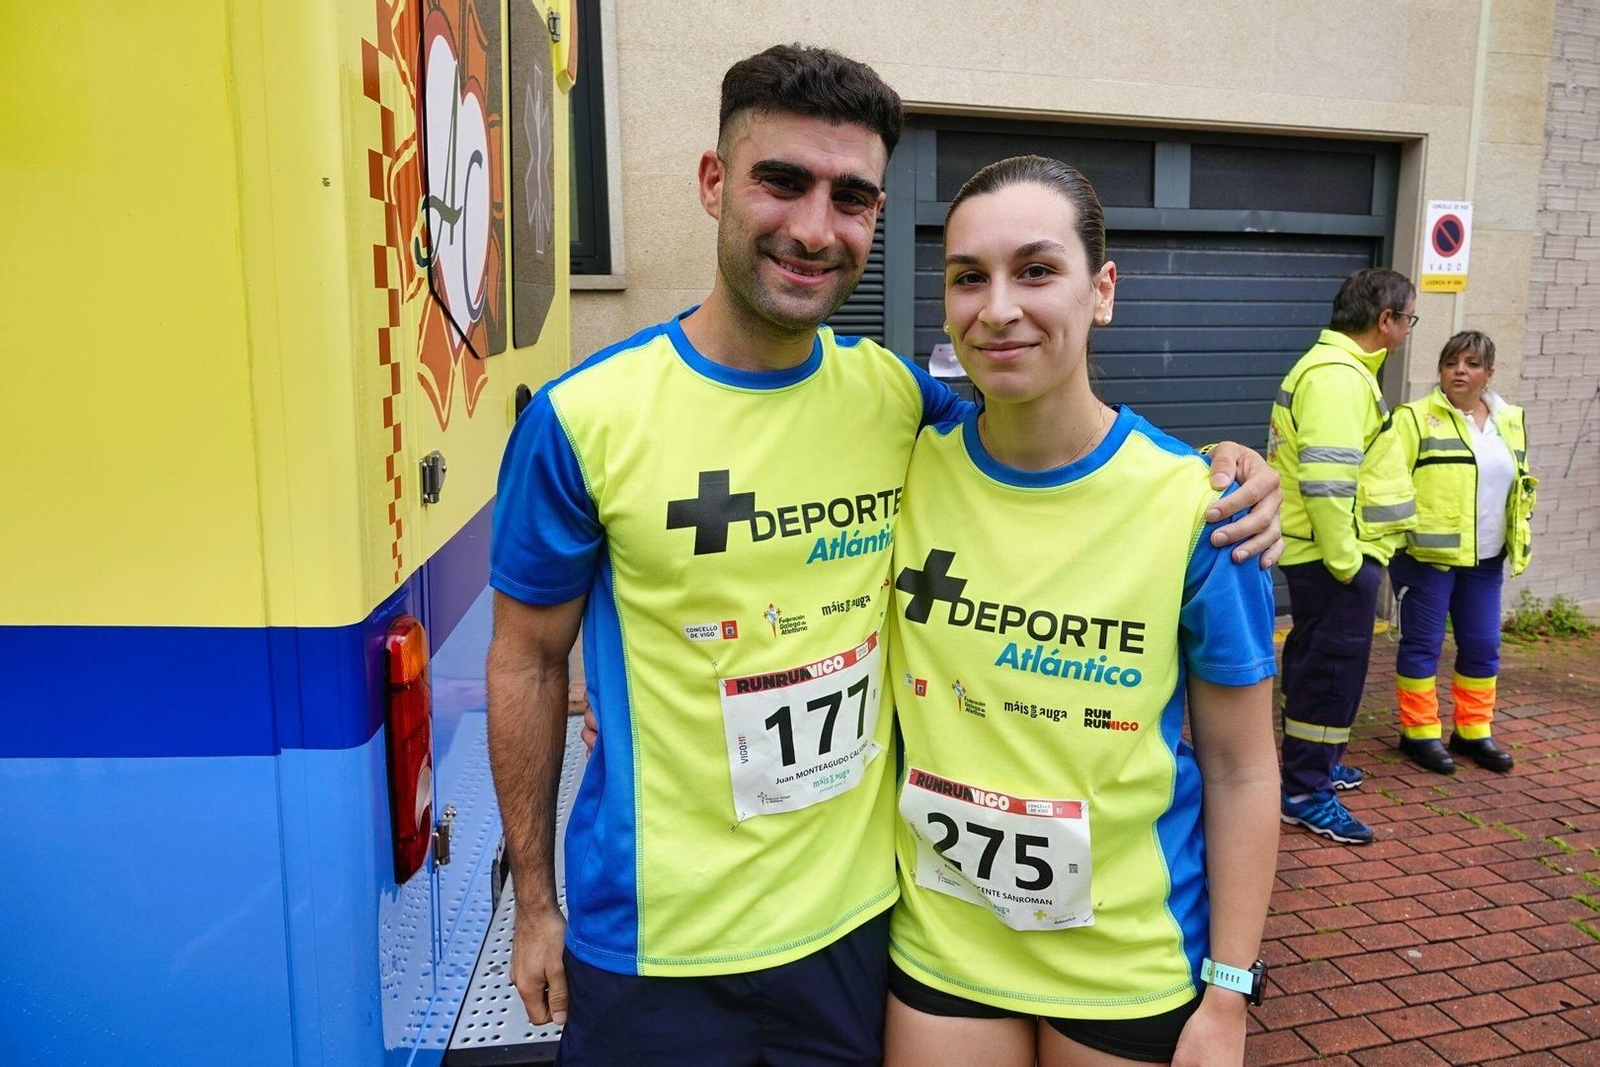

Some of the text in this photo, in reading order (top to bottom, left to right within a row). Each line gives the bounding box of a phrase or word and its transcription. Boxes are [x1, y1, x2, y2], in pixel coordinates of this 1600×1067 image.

[750, 486, 903, 542] DEPORTE
[685, 625, 718, 633] CONCELLO
[781, 626, 807, 635] Atletismo
[948, 597, 1146, 655] DEPORTE
[994, 642, 1143, 688] Atlántico
[764, 674, 869, 767] 177
[1004, 701, 1029, 715] máis
[1039, 707, 1067, 722] auga
[1083, 708, 1111, 719] RUN
[775, 775, 794, 785] Juan
[795, 756, 849, 779] MONTEAGUDO
[927, 812, 1054, 891] 275
[1002, 893, 1053, 905] SANROMAN
